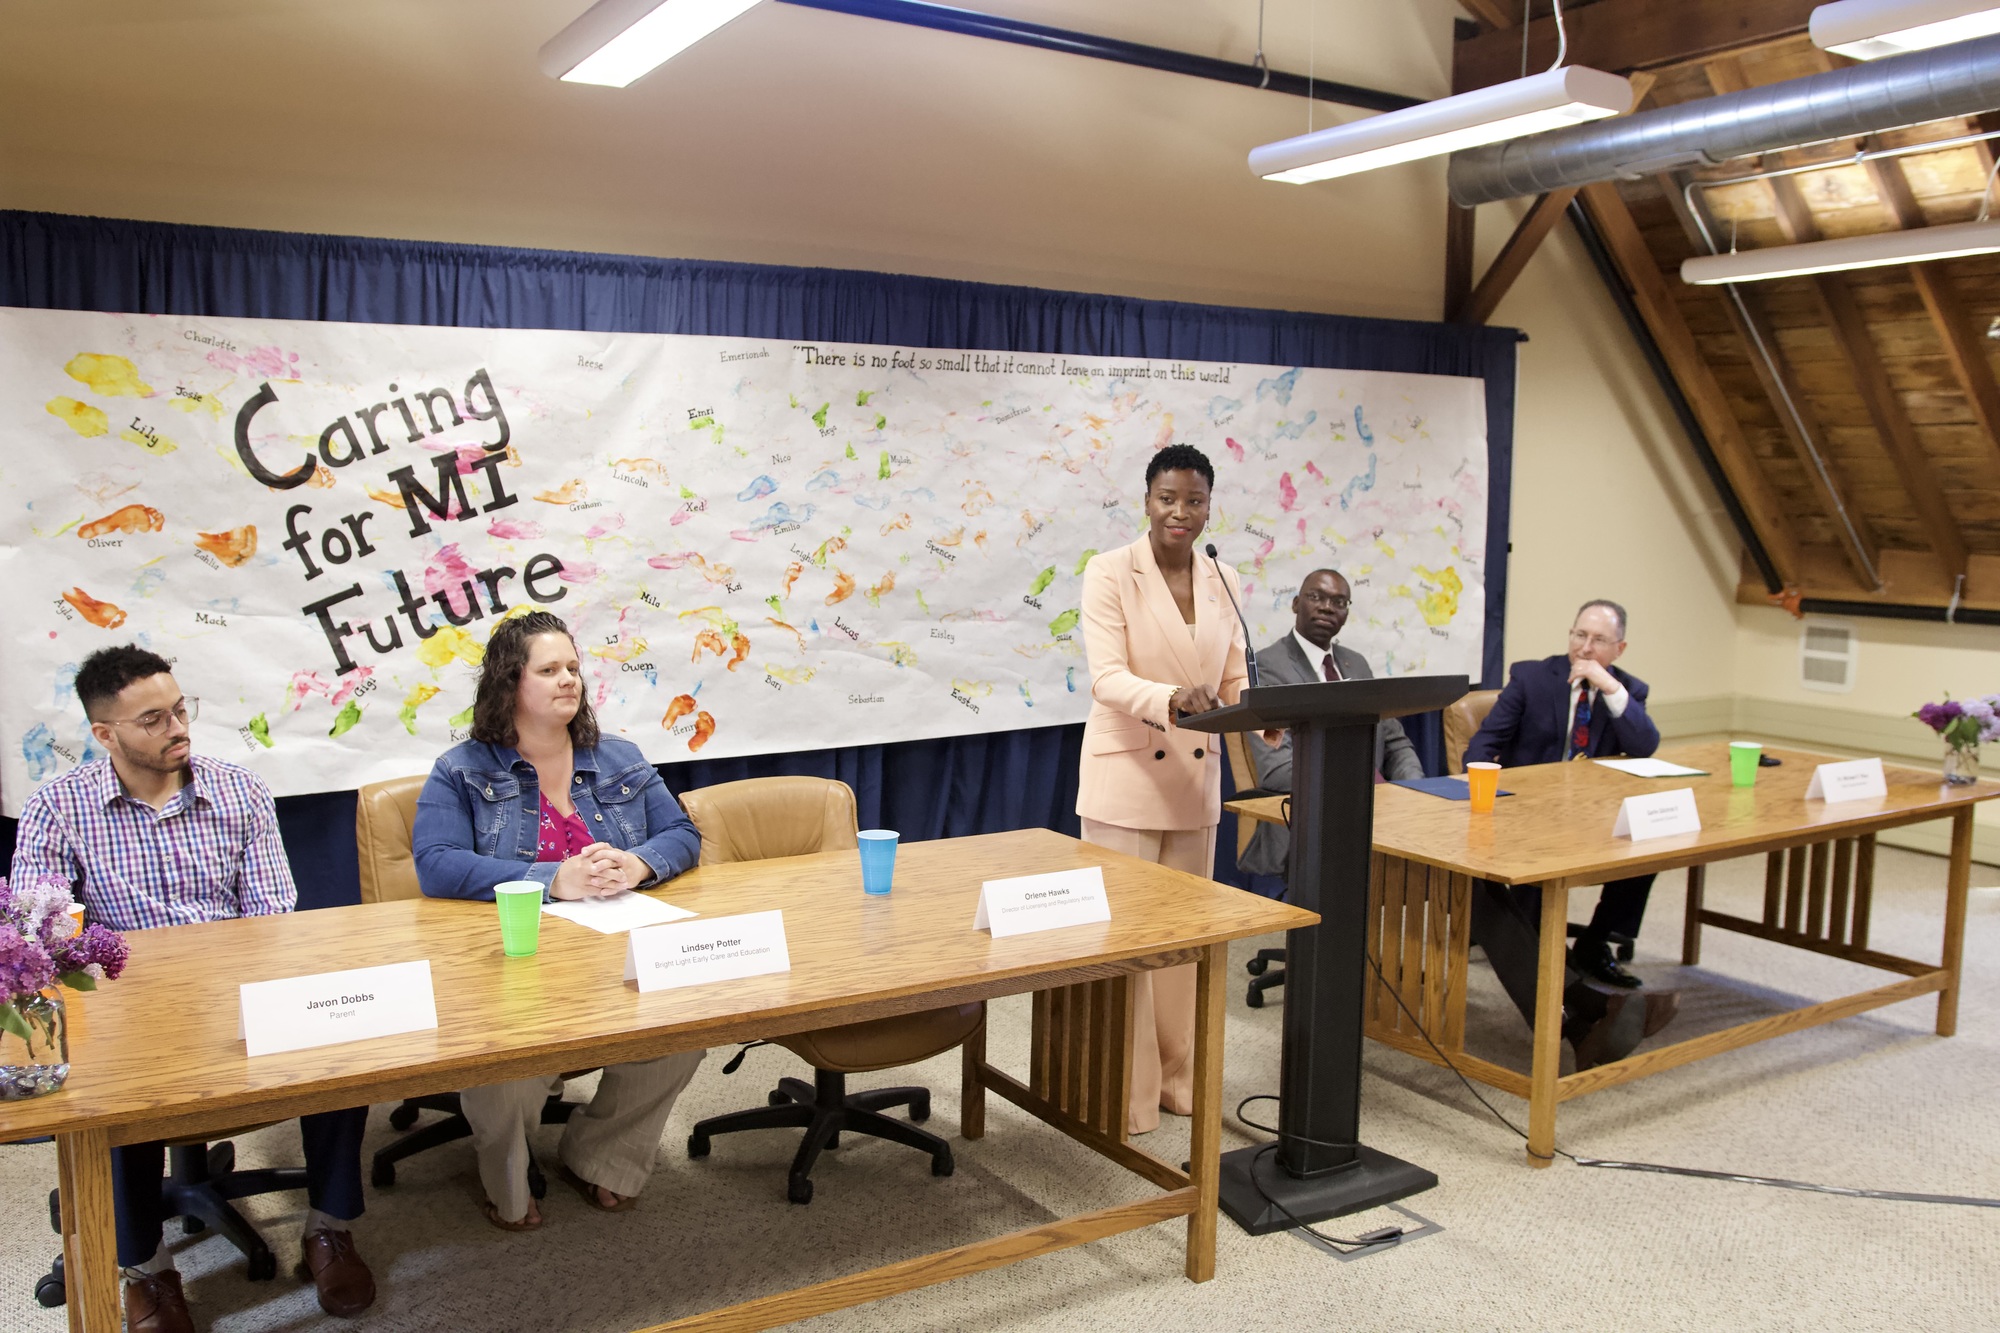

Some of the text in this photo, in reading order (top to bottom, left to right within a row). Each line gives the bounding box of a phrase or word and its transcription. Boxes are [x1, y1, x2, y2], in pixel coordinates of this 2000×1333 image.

[184, 330, 237, 352] Charlotte
[577, 355, 604, 370] Reese
[852, 351, 866, 366] is
[871, 354, 888, 368] no
[892, 350, 915, 369] foot
[919, 358, 932, 370] so
[935, 353, 970, 372] small
[974, 354, 1000, 373] that
[1003, 356, 1014, 373] it
[1016, 358, 1056, 376] cannot
[1061, 359, 1089, 376] leave
[1090, 366, 1105, 377] an
[1108, 361, 1152, 384] imprint
[1154, 370, 1168, 378] on
[1171, 363, 1196, 381] this
[176, 386, 203, 403] Josie
[688, 406, 714, 420] Emri
[129, 416, 159, 448] Lily
[234, 368, 511, 490] Caring
[772, 454, 791, 465] Nico
[612, 470, 649, 488] Lincoln
[569, 500, 603, 512] Graham
[282, 451, 518, 581] for MI
[87, 538, 123, 549] Oliver
[925, 539, 956, 562] Spencer
[789, 543, 815, 566] Leigha
[640, 591, 661, 608] Mila
[1023, 595, 1042, 610] Gabe
[53, 598, 74, 621] Ayla
[302, 553, 568, 677] Future
[195, 612, 227, 627] Mack
[834, 616, 860, 641] Lucas
[930, 628, 955, 644] Eisley
[605, 634, 619, 645] LJ
[621, 662, 654, 673] Owen
[353, 677, 377, 699] Gigi
[765, 674, 783, 691] Bari
[848, 694, 885, 705] Sebastian
[951, 688, 980, 715] Easton
[46, 737, 78, 764] Zaiden
[1025, 888, 1070, 900] Orlene Hawks
[1026, 902, 1048, 910] Licensing
[681, 938, 742, 954] Lindsey Potter
[655, 959, 675, 969] Bright
[676, 957, 691, 967] Light
[692, 954, 709, 964] Early
[710, 952, 726, 961] Care
[740, 946, 771, 957] Education
[307, 993, 375, 1010] Javon Dobbs
[329, 1009, 356, 1019] Parent
